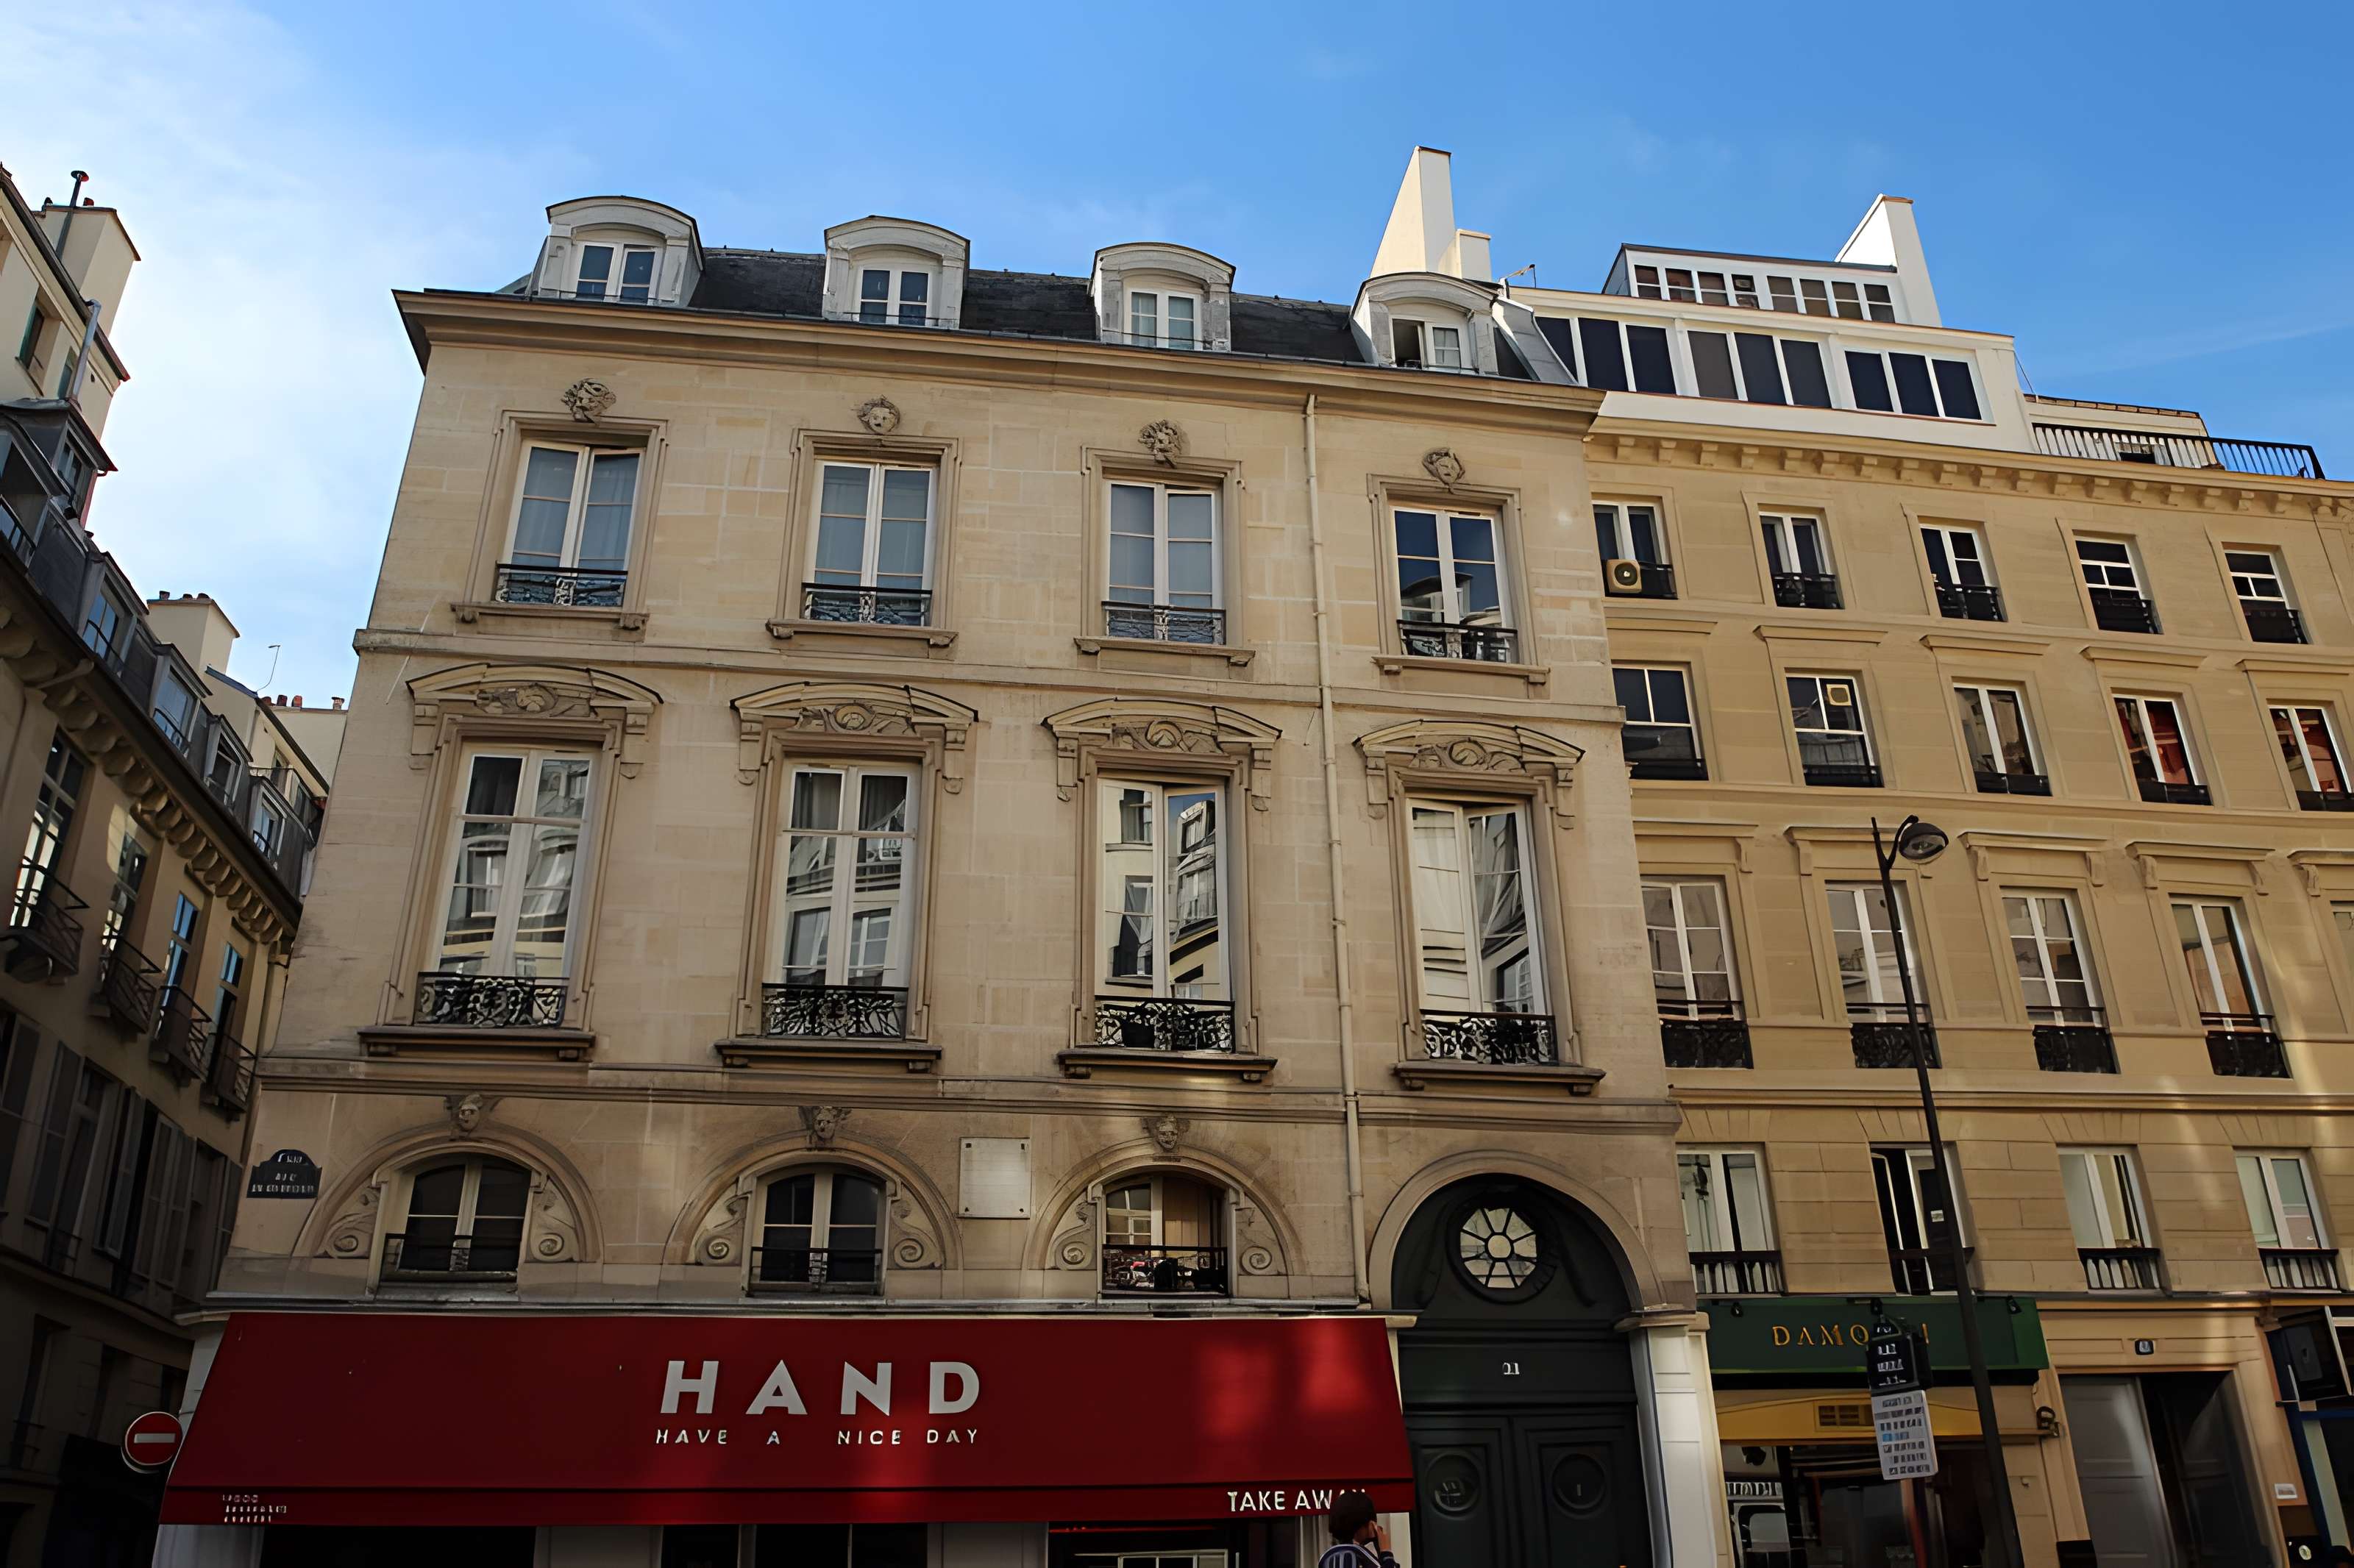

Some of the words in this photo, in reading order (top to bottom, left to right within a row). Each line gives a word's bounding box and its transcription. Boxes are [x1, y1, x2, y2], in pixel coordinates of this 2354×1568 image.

[660, 1359, 980, 1416] HAND
[655, 1429, 728, 1444] HAVE
[766, 1430, 780, 1445] A
[837, 1429, 902, 1445] NICE
[926, 1428, 978, 1444] DAY
[1227, 1490, 1286, 1512] TAKE
[1294, 1489, 1366, 1511] AW
